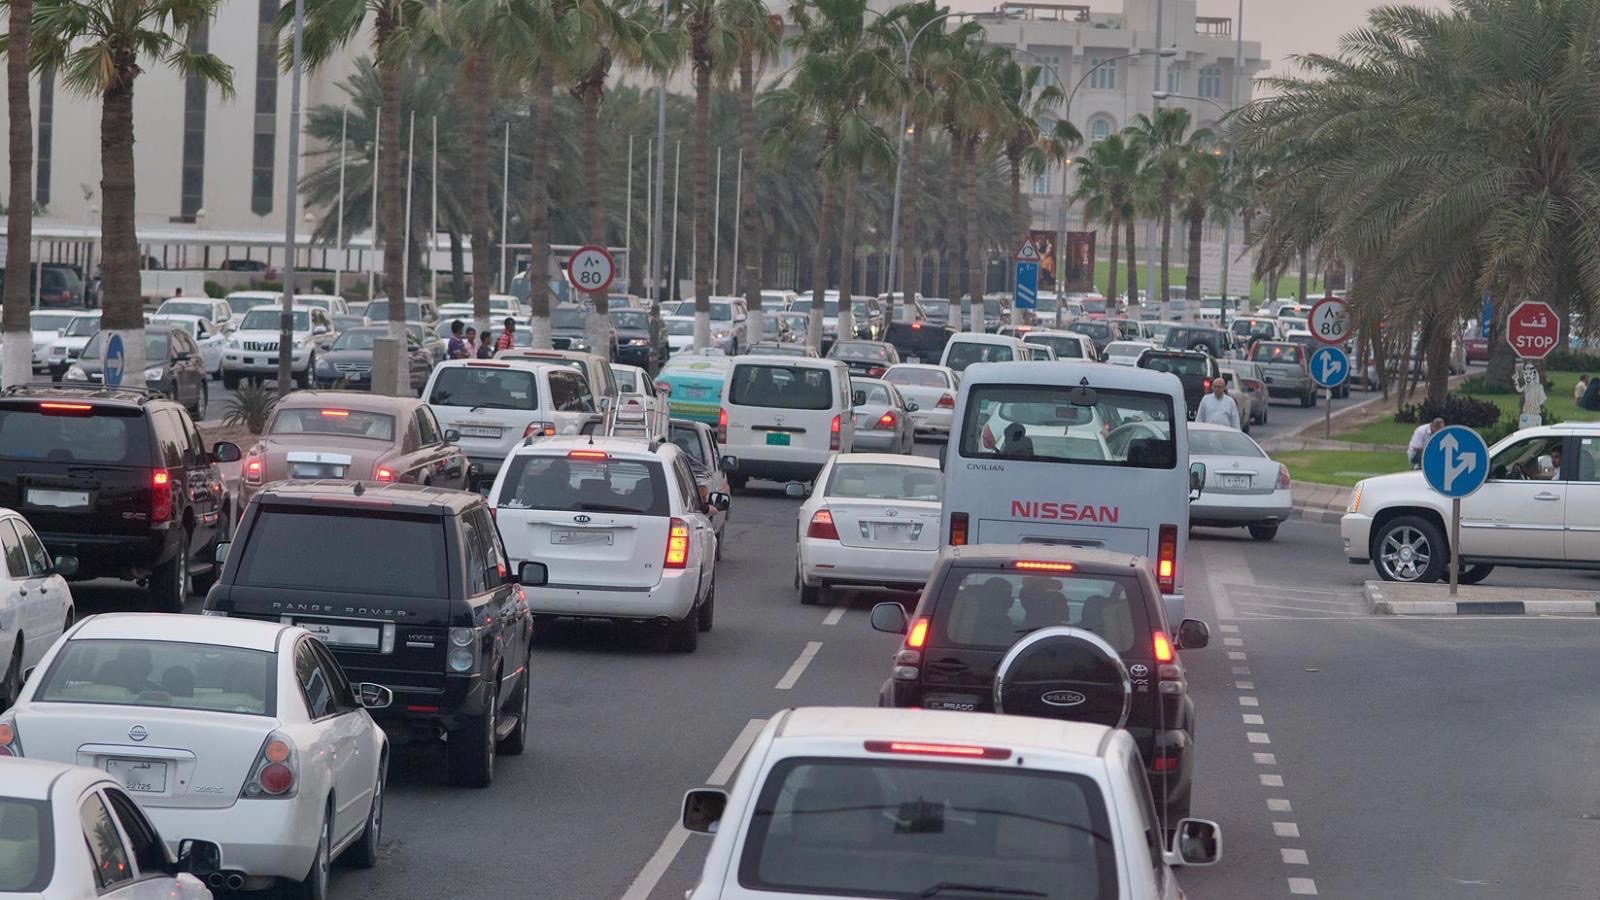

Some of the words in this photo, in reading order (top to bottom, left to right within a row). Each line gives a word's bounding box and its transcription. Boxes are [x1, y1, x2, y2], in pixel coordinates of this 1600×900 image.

[584, 256, 600, 267] ٨٠
[580, 271, 602, 284] 80
[1520, 312, 1547, 328] قف
[1321, 322, 1342, 335] 80
[1516, 335, 1553, 348] STOP
[966, 463, 1005, 471] CIVILIAN
[1011, 500, 1119, 523] NISSAN
[272, 601, 333, 612] RANGE
[345, 606, 407, 617] ROVER
[1046, 694, 1082, 702] PRADO
[943, 702, 974, 711] PRADO
